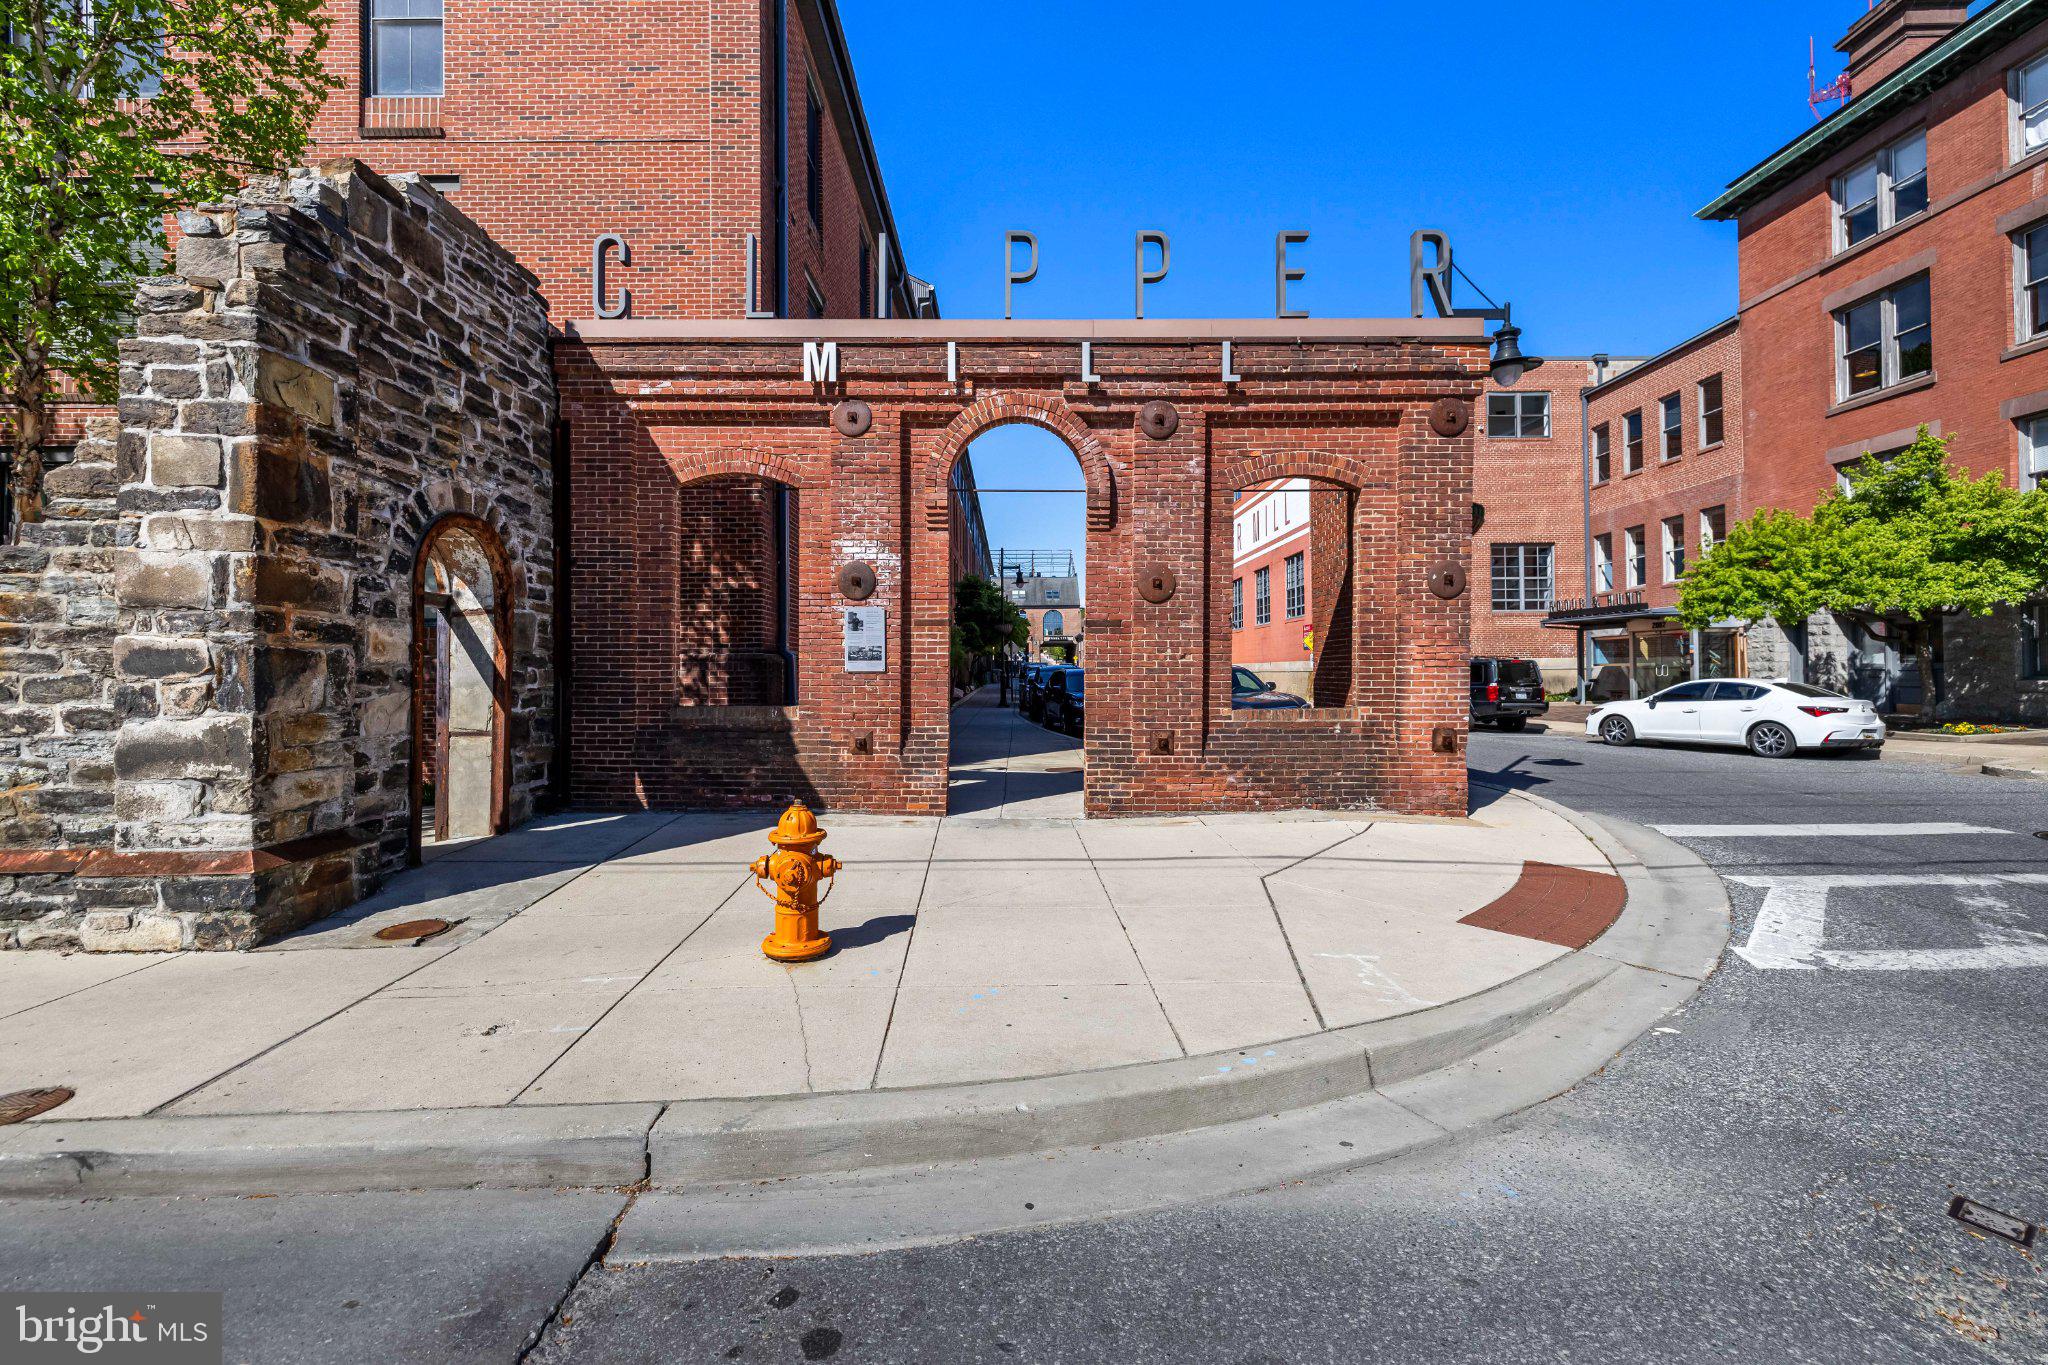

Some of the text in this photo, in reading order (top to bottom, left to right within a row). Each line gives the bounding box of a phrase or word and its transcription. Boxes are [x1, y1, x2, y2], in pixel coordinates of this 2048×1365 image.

[592, 229, 1454, 319] CLIPPER
[802, 341, 1241, 383] MILL
[1252, 492, 1291, 543] MILL
[1607, 590, 1641, 606] HUNT
